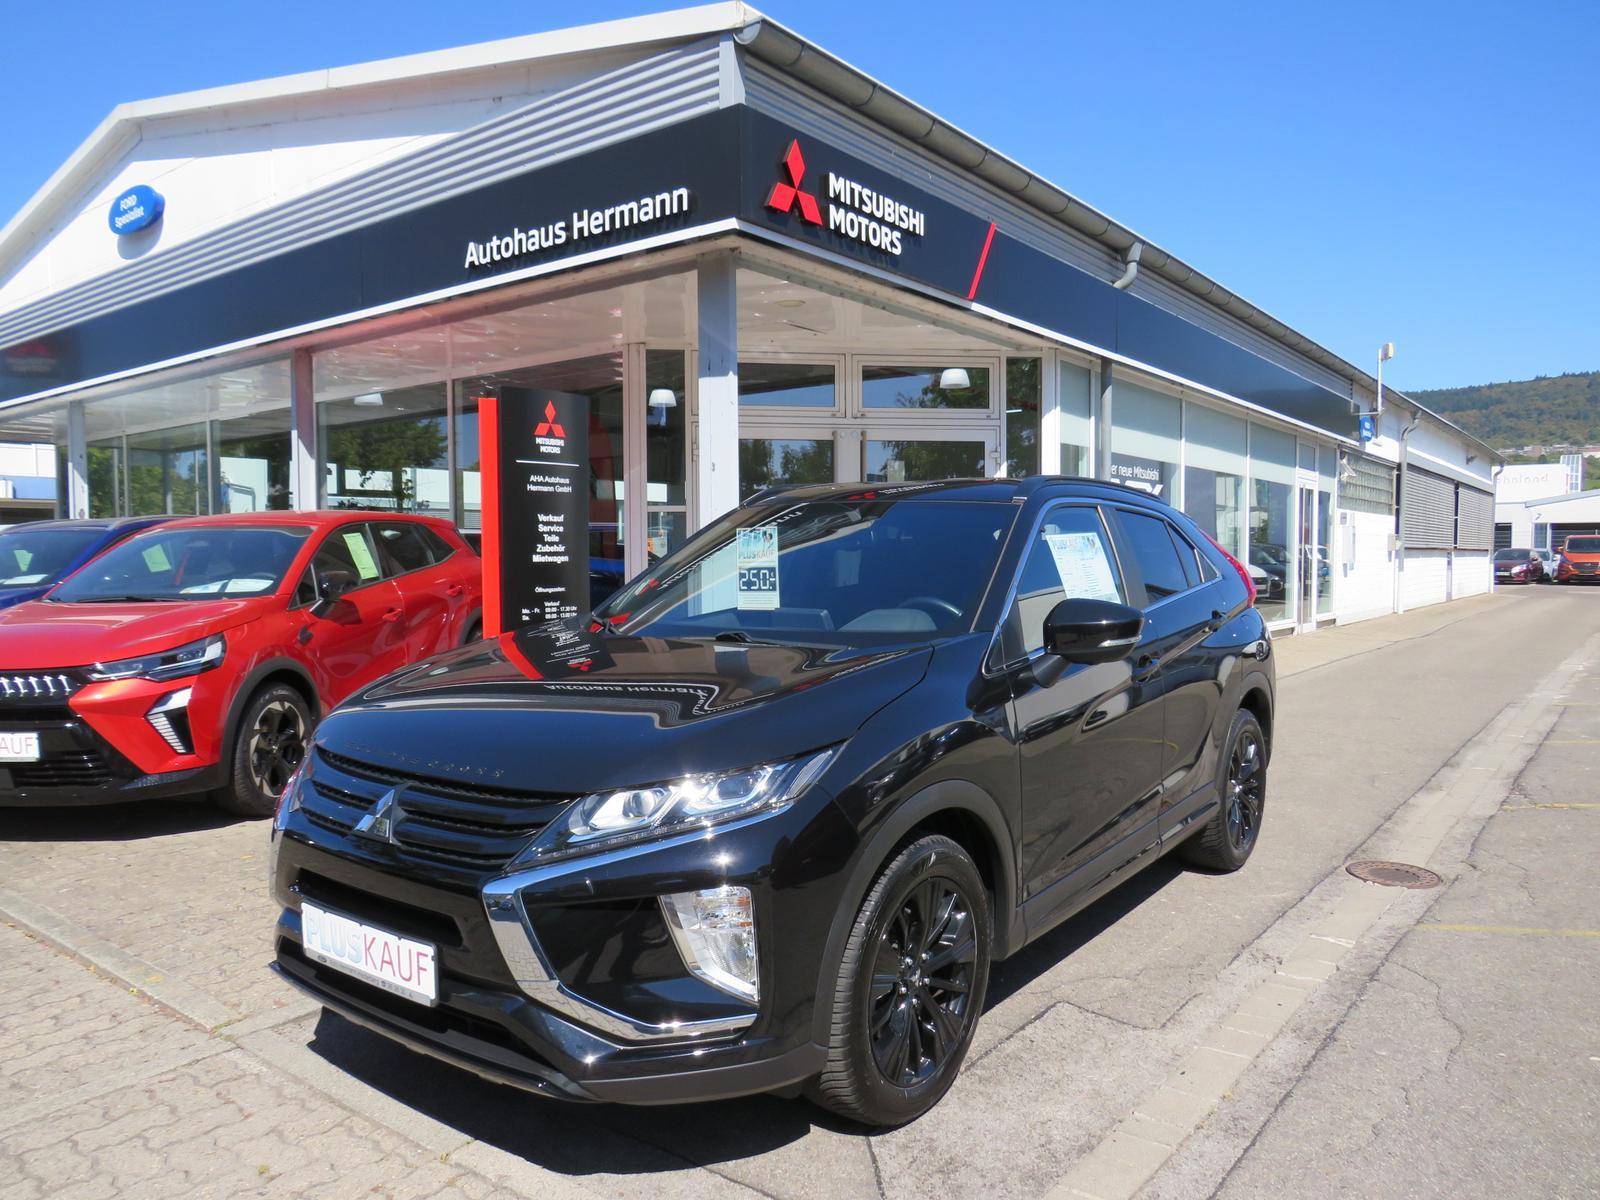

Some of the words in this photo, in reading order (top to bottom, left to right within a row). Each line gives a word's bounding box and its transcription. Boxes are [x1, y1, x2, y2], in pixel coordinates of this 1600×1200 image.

[119, 194, 138, 212] FORD
[828, 172, 926, 238] MITSUBISHI
[464, 222, 567, 269] Autohaus
[572, 186, 689, 240] Hermann
[828, 203, 903, 256] MOTORS
[535, 437, 565, 447] MITSUBISHI
[539, 445, 561, 454] MOTORS
[1118, 466, 1133, 477] neue
[1133, 466, 1160, 481] Mitsubishi
[529, 474, 545, 483] AHA
[544, 475, 570, 484] Autohaus
[527, 483, 555, 492] Hermann
[554, 485, 572, 493] GmbH
[537, 513, 565, 522] Verkauf
[538, 523, 564, 533] Service
[542, 533, 560, 542] Teile
[536, 544, 566, 553] Zubehör
[532, 554, 569, 563] Mietwagen
[0, 736, 33, 754] AUF
[306, 911, 429, 987] PLUSKAUF
